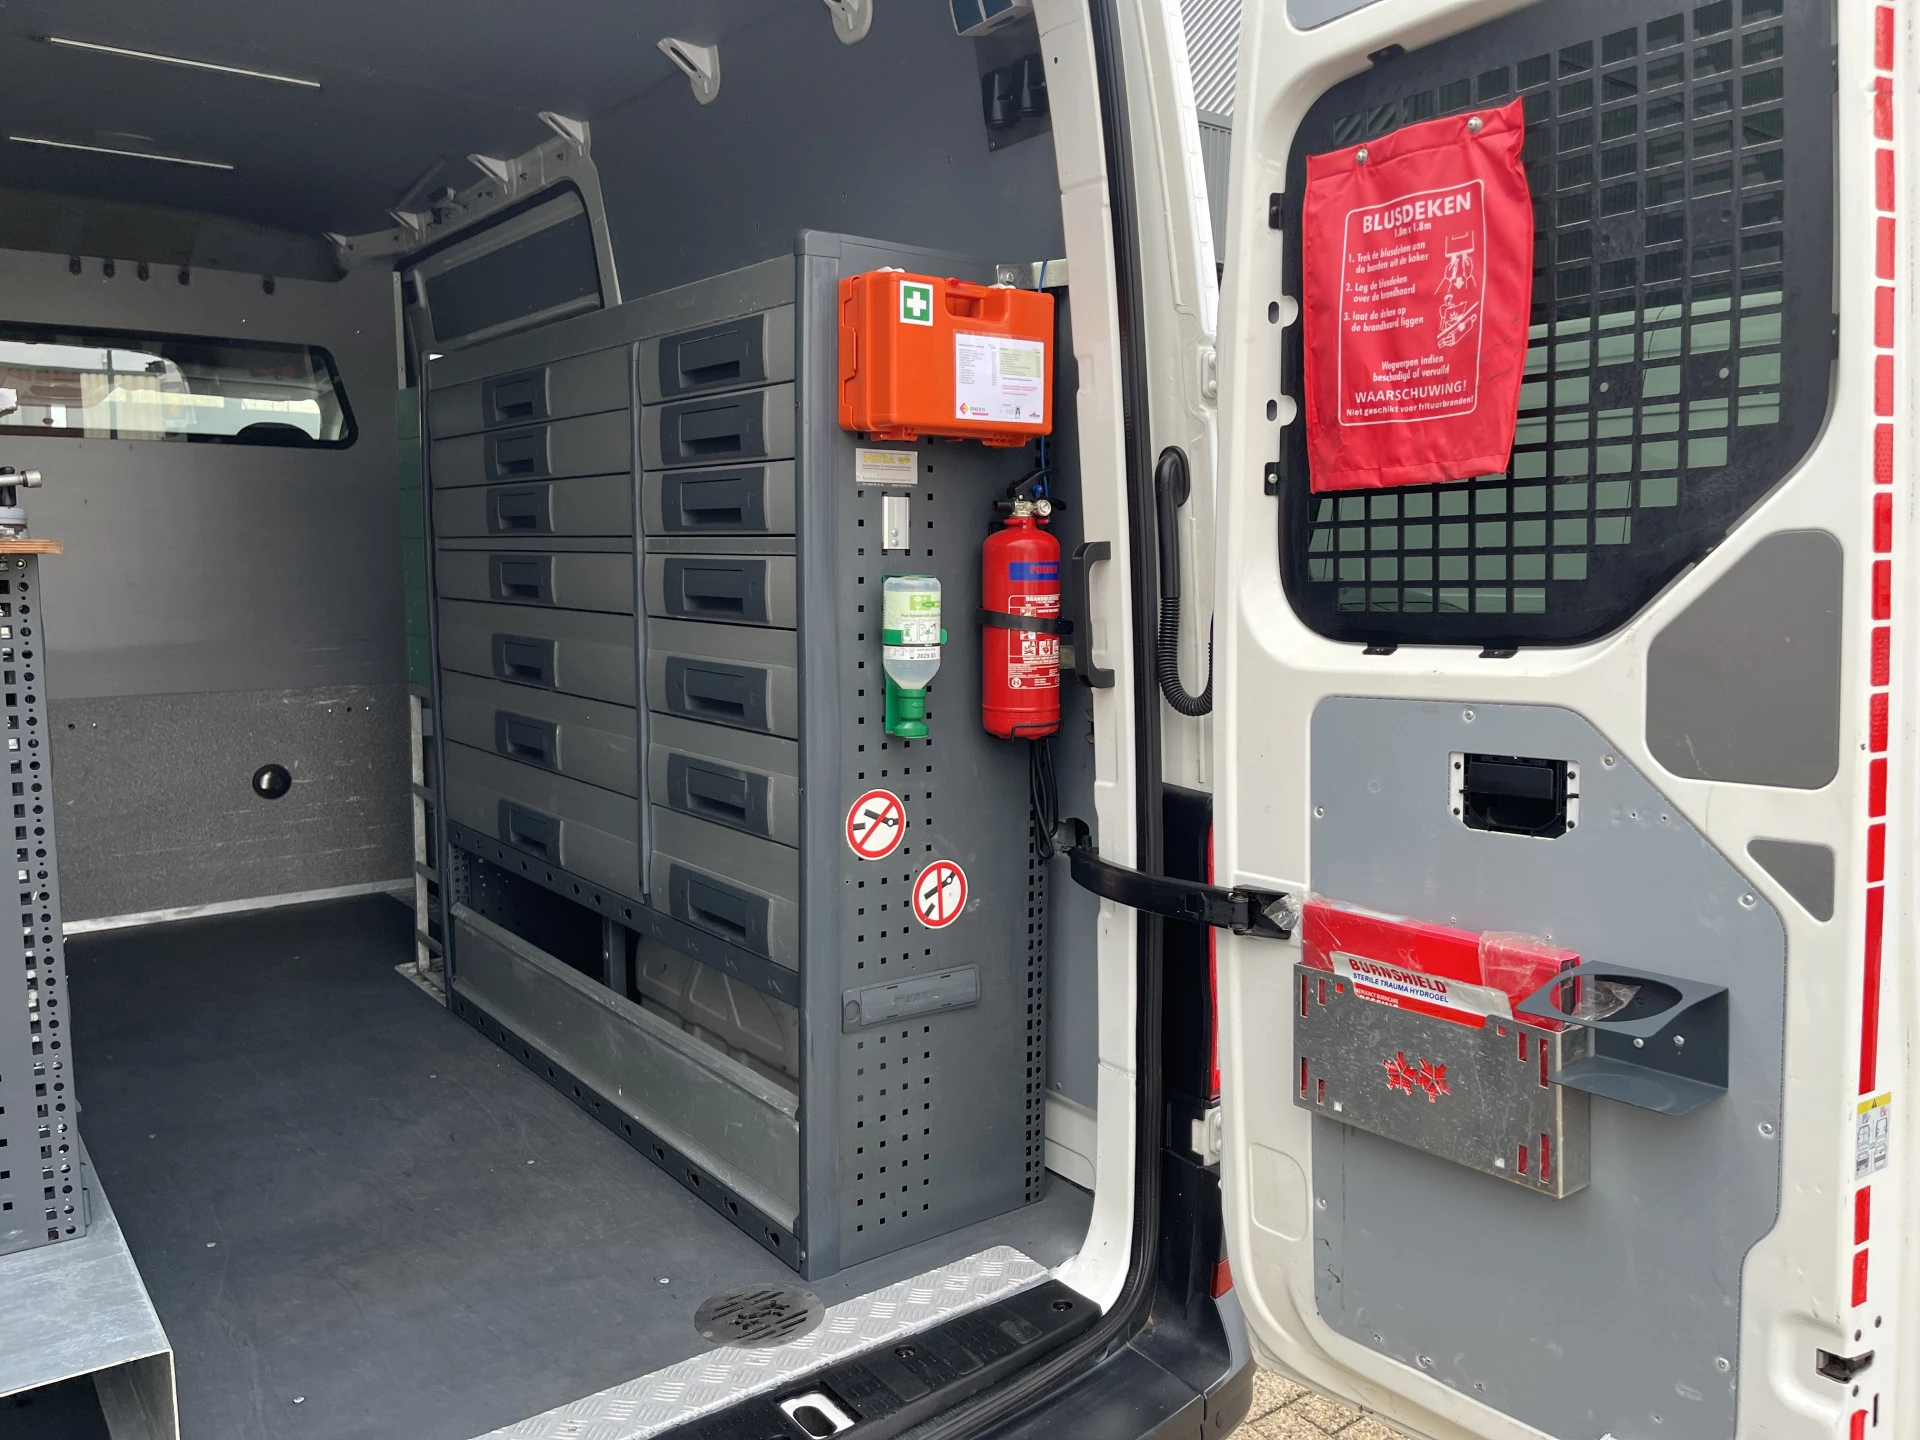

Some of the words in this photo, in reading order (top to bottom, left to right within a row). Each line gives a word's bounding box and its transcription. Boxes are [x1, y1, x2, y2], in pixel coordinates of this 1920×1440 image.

[1363, 191, 1471, 234] BLUSDEKEN
[1412, 222, 1432, 233] 1.8m
[1348, 253, 1355, 263] 1.
[1357, 253, 1371, 263] Trek
[1371, 251, 1379, 260] de
[1380, 245, 1411, 257] blusdeken
[1412, 242, 1426, 251] aan
[1355, 264, 1365, 274] de
[1399, 256, 1407, 265] de
[1408, 252, 1429, 263] koker
[1345, 283, 1353, 292] 2.
[1355, 283, 1368, 294] Leg
[1369, 280, 1378, 290] de
[1379, 275, 1408, 289] blusdeken
[1353, 295, 1370, 303] over
[1371, 292, 1380, 302] de
[1380, 284, 1416, 300] brandhaard
[1343, 312, 1351, 321] 3.
[1369, 310, 1379, 320] de
[1380, 308, 1397, 319] deken
[1397, 307, 1407, 317] op
[1351, 322, 1361, 332] de
[1363, 318, 1399, 332] brandhaard
[1400, 316, 1424, 328] liggen
[1381, 358, 1419, 372] Wegwerpen
[1420, 354, 1444, 366] indien
[1372, 371, 1411, 383] beschadigd
[1412, 368, 1420, 379] of
[1421, 364, 1450, 377] vervuild
[1355, 380, 1467, 404] WAARSCHUWING!
[1346, 408, 1363, 417] Niet
[1364, 406, 1399, 417] geschikt
[1400, 405, 1417, 413] voor
[1418, 394, 1475, 411] frituurbranden!
[1348, 958, 1447, 994] BURNSHIELD
[1353, 972, 1379, 985] STERILE
[1380, 979, 1409, 993] TRAUMA
[1409, 987, 1449, 1003] HYDROGEL
